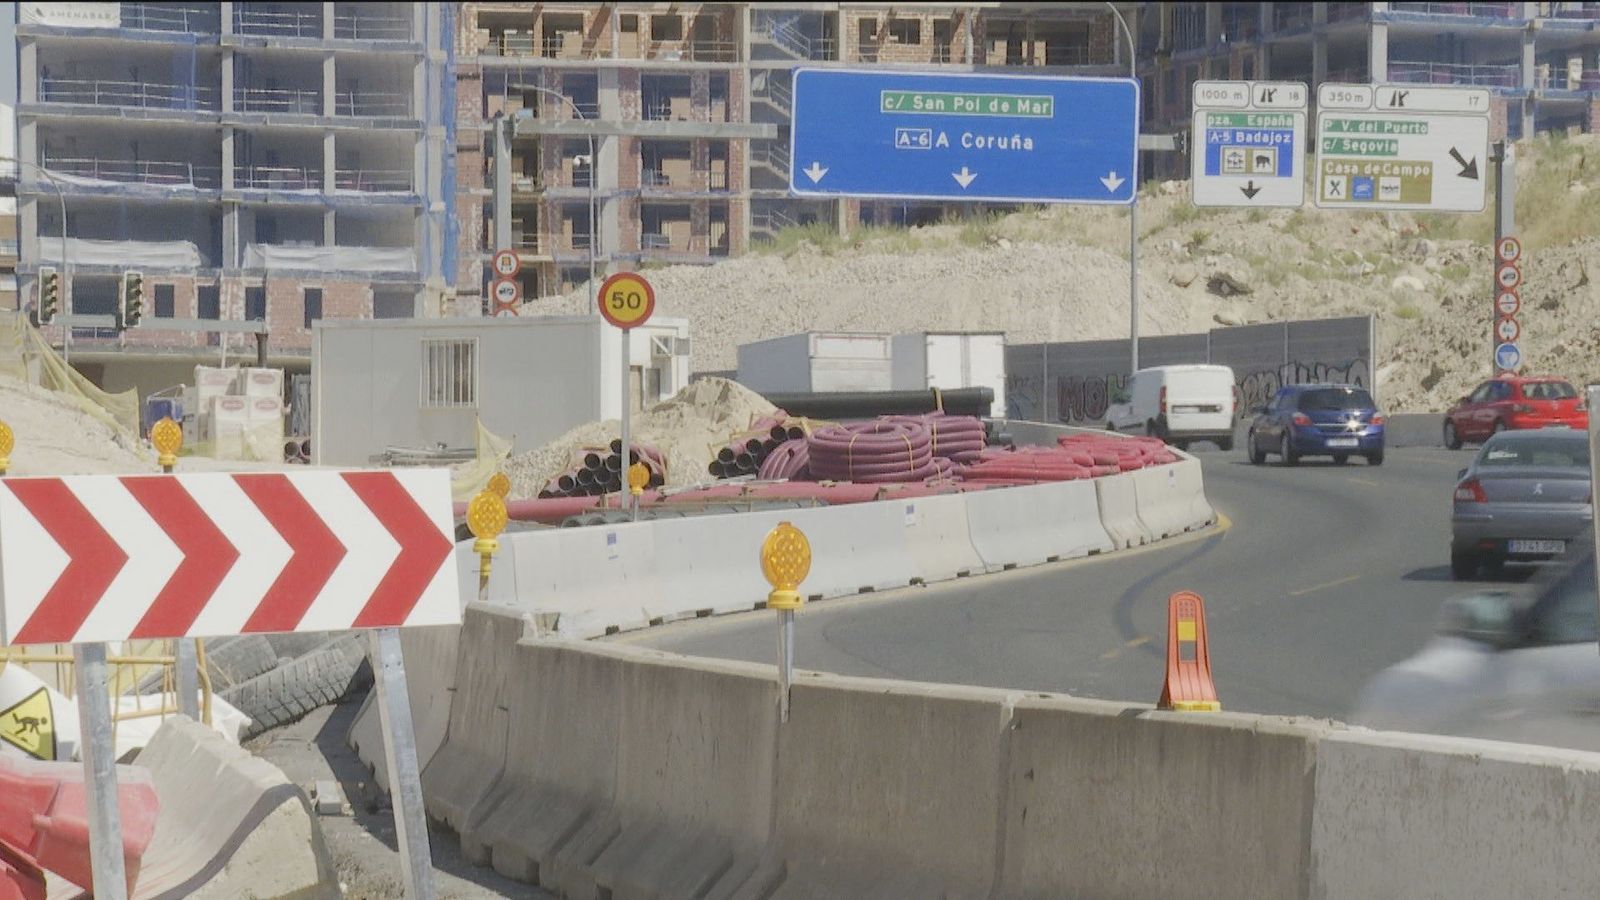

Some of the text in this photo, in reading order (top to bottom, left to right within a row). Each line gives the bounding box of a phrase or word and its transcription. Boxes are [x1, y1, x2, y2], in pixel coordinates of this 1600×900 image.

[1201, 90, 1243, 100] 1000 m
[1288, 91, 1300, 101] 18
[1328, 91, 1364, 102] 350 m
[1469, 95, 1480, 105] 17
[884, 95, 1049, 114] c/ San Pol de Mar
[1247, 115, 1293, 128] España
[1342, 121, 1353, 131] V.
[1358, 121, 1378, 132] del
[1384, 122, 1428, 133] Puerto
[898, 131, 1034, 150] A-6 A Coruña
[1210, 130, 1291, 145] A-5 Badajoz
[1323, 138, 1398, 154] c/ Segovia
[1325, 161, 1430, 178] Casa de Campo
[611, 291, 641, 310] 50
